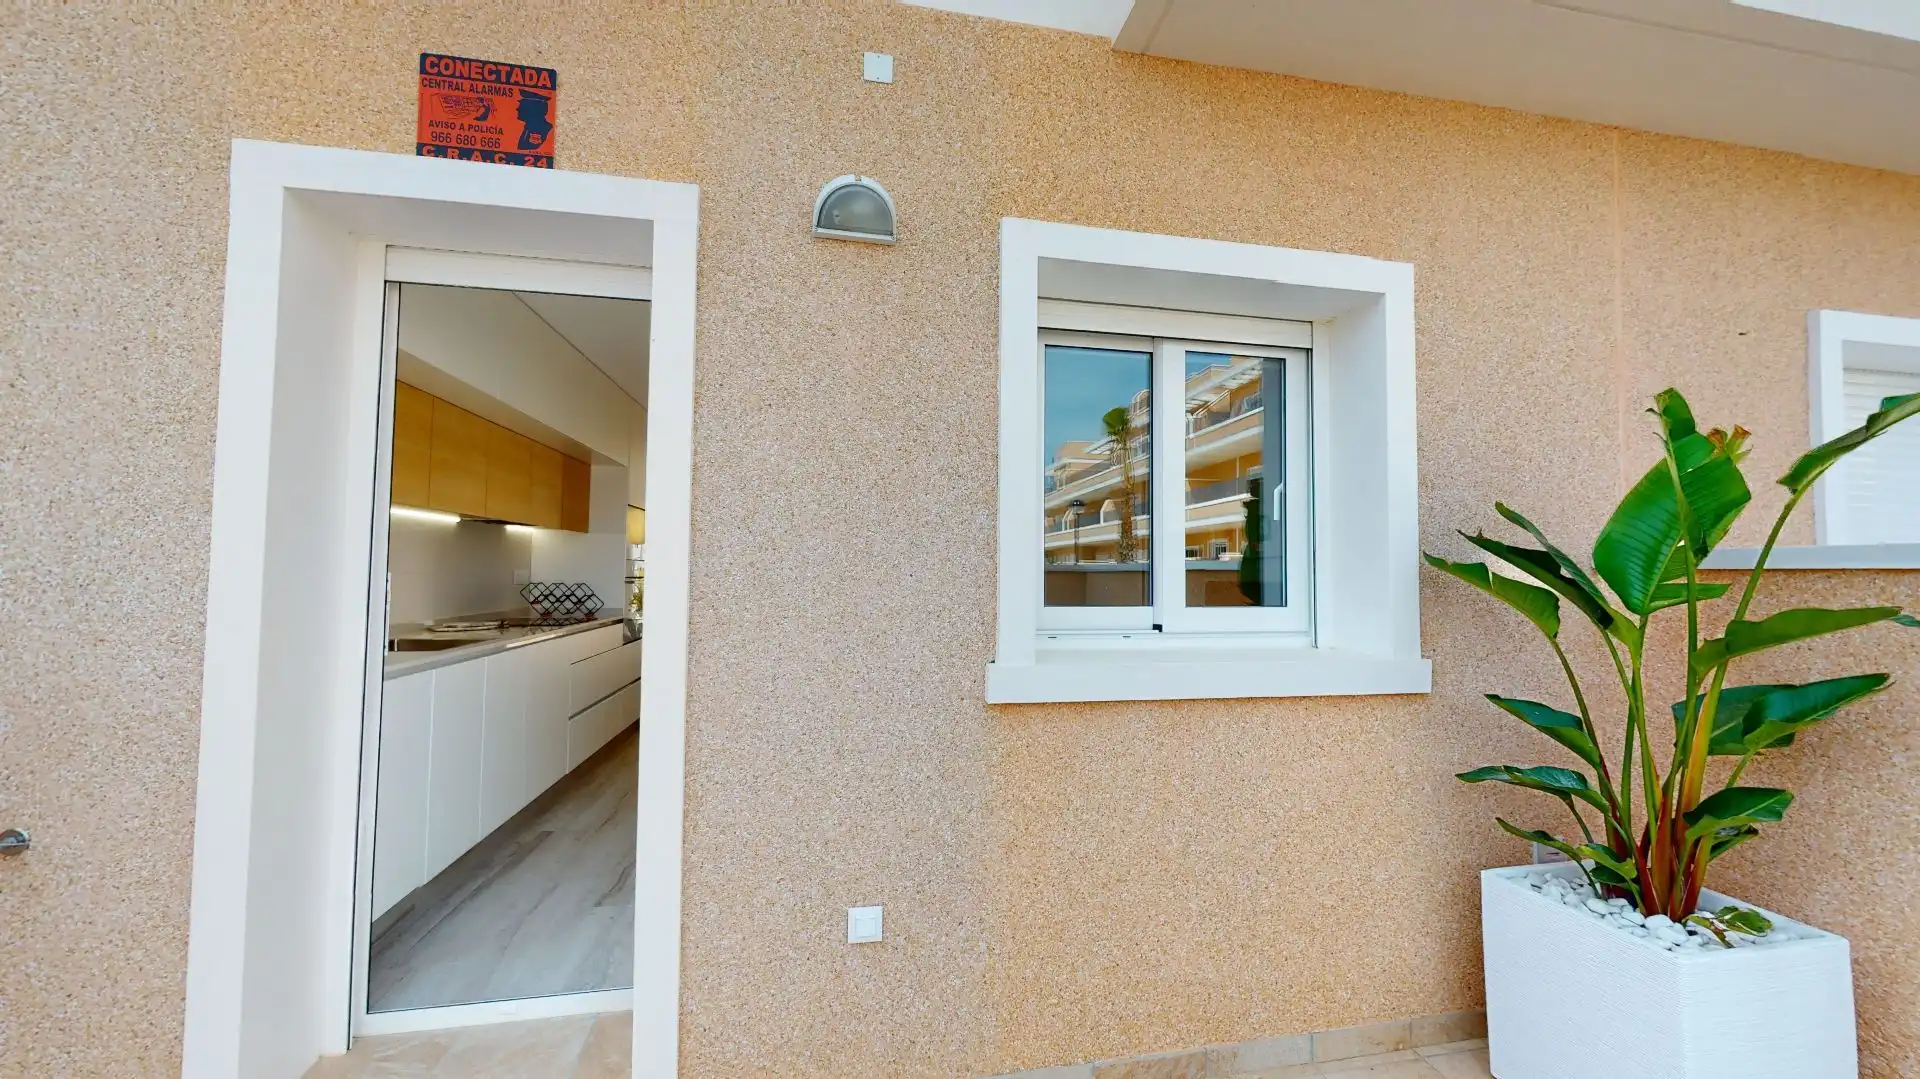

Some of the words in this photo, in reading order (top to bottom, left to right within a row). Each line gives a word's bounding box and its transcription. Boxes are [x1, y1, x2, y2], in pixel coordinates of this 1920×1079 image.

[425, 56, 552, 88] CONECTADA
[421, 78, 465, 92] CENTRAL
[469, 84, 514, 98] ALARMAS
[428, 119, 456, 130] AVISO
[458, 122, 465, 131] A
[468, 123, 504, 135] POLICÍA
[430, 130, 452, 143] 966
[456, 134, 477, 146] 680
[480, 136, 501, 149] 666
[524, 156, 548, 168] 24
